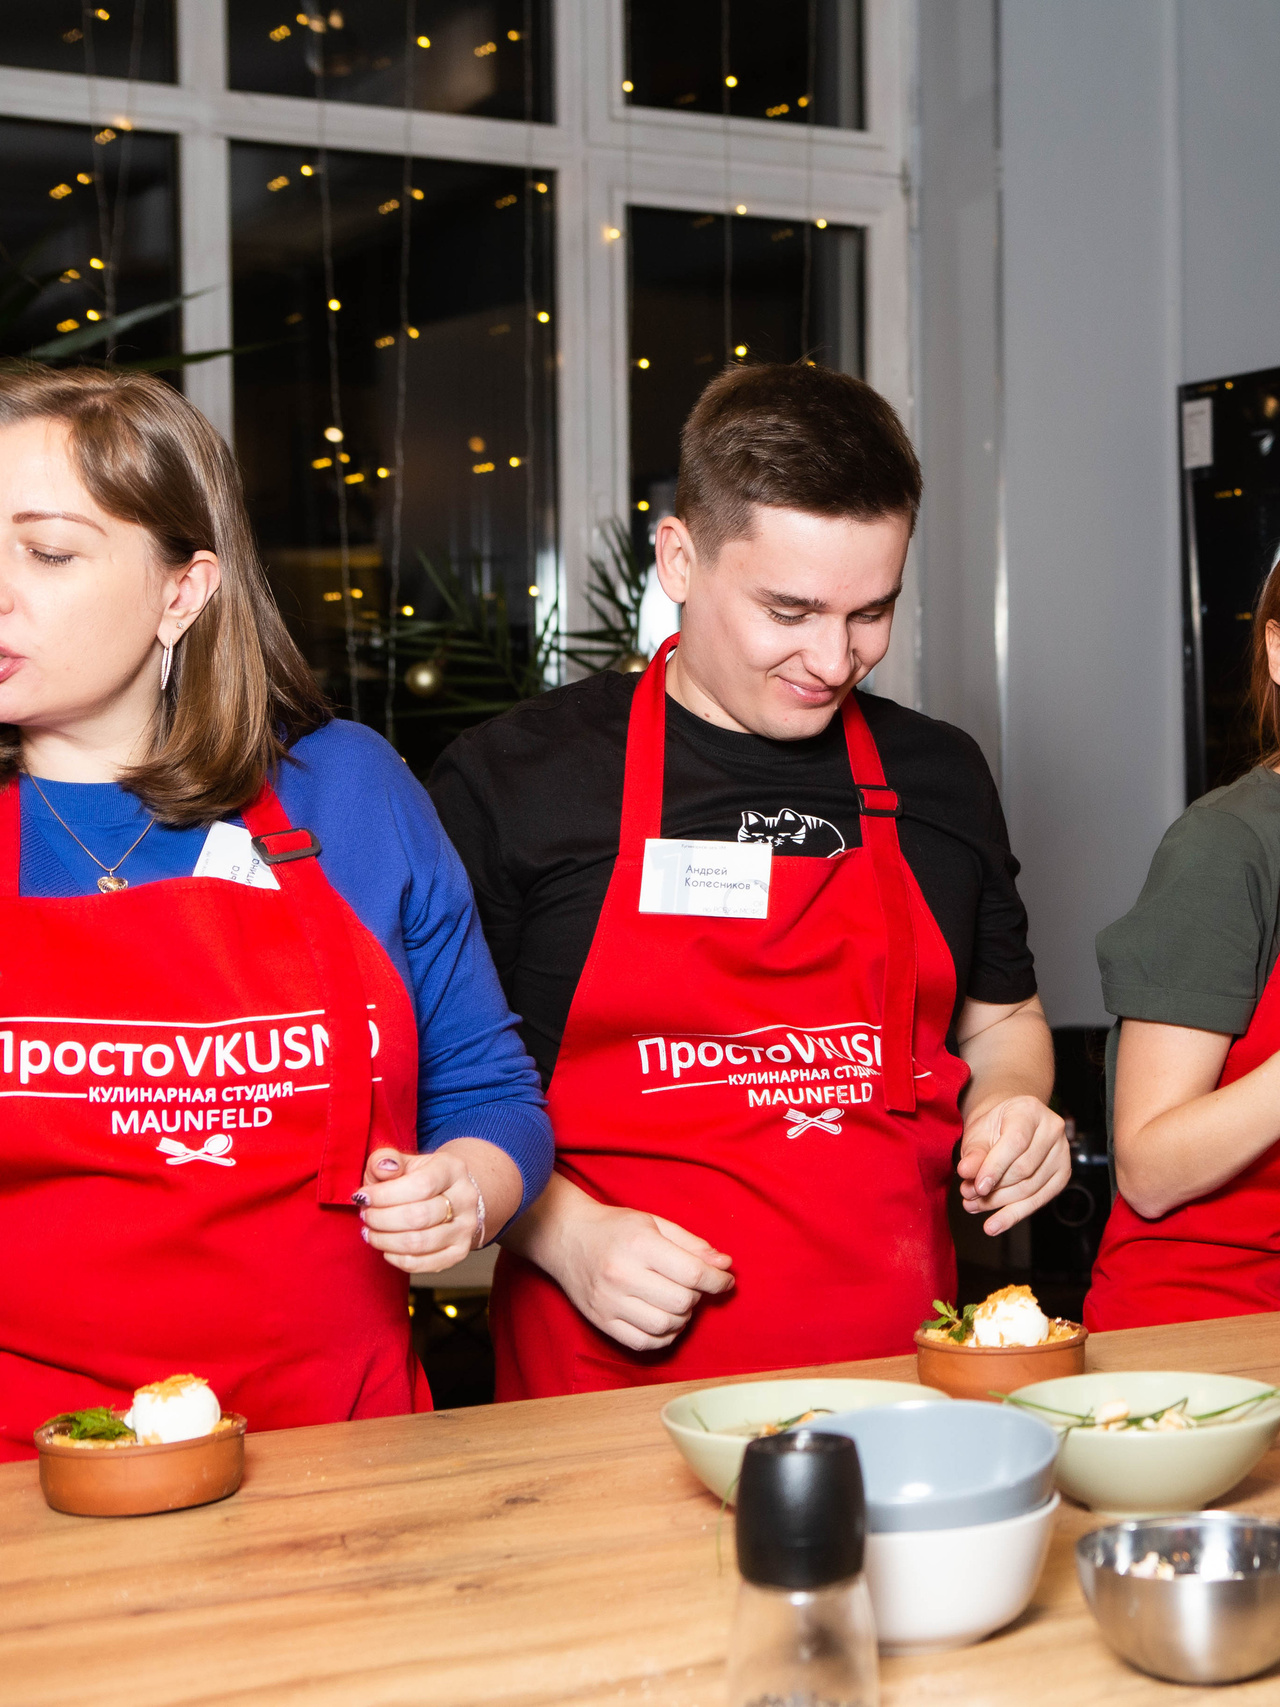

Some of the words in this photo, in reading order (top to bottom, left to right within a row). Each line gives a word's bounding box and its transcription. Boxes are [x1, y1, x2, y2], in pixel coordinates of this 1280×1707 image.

[229, 865, 240, 880] ьга
[245, 858, 260, 885] итина
[685, 864, 728, 876] Андрей
[728, 1068, 831, 1086] КУЛИНАРНАЯ
[89, 1087, 217, 1103] КУЛИНАРНАЯ
[221, 1082, 294, 1103] СТУДИЯ
[748, 1082, 873, 1107] MAUNFELD
[112, 1106, 273, 1135] MAUNFELD
